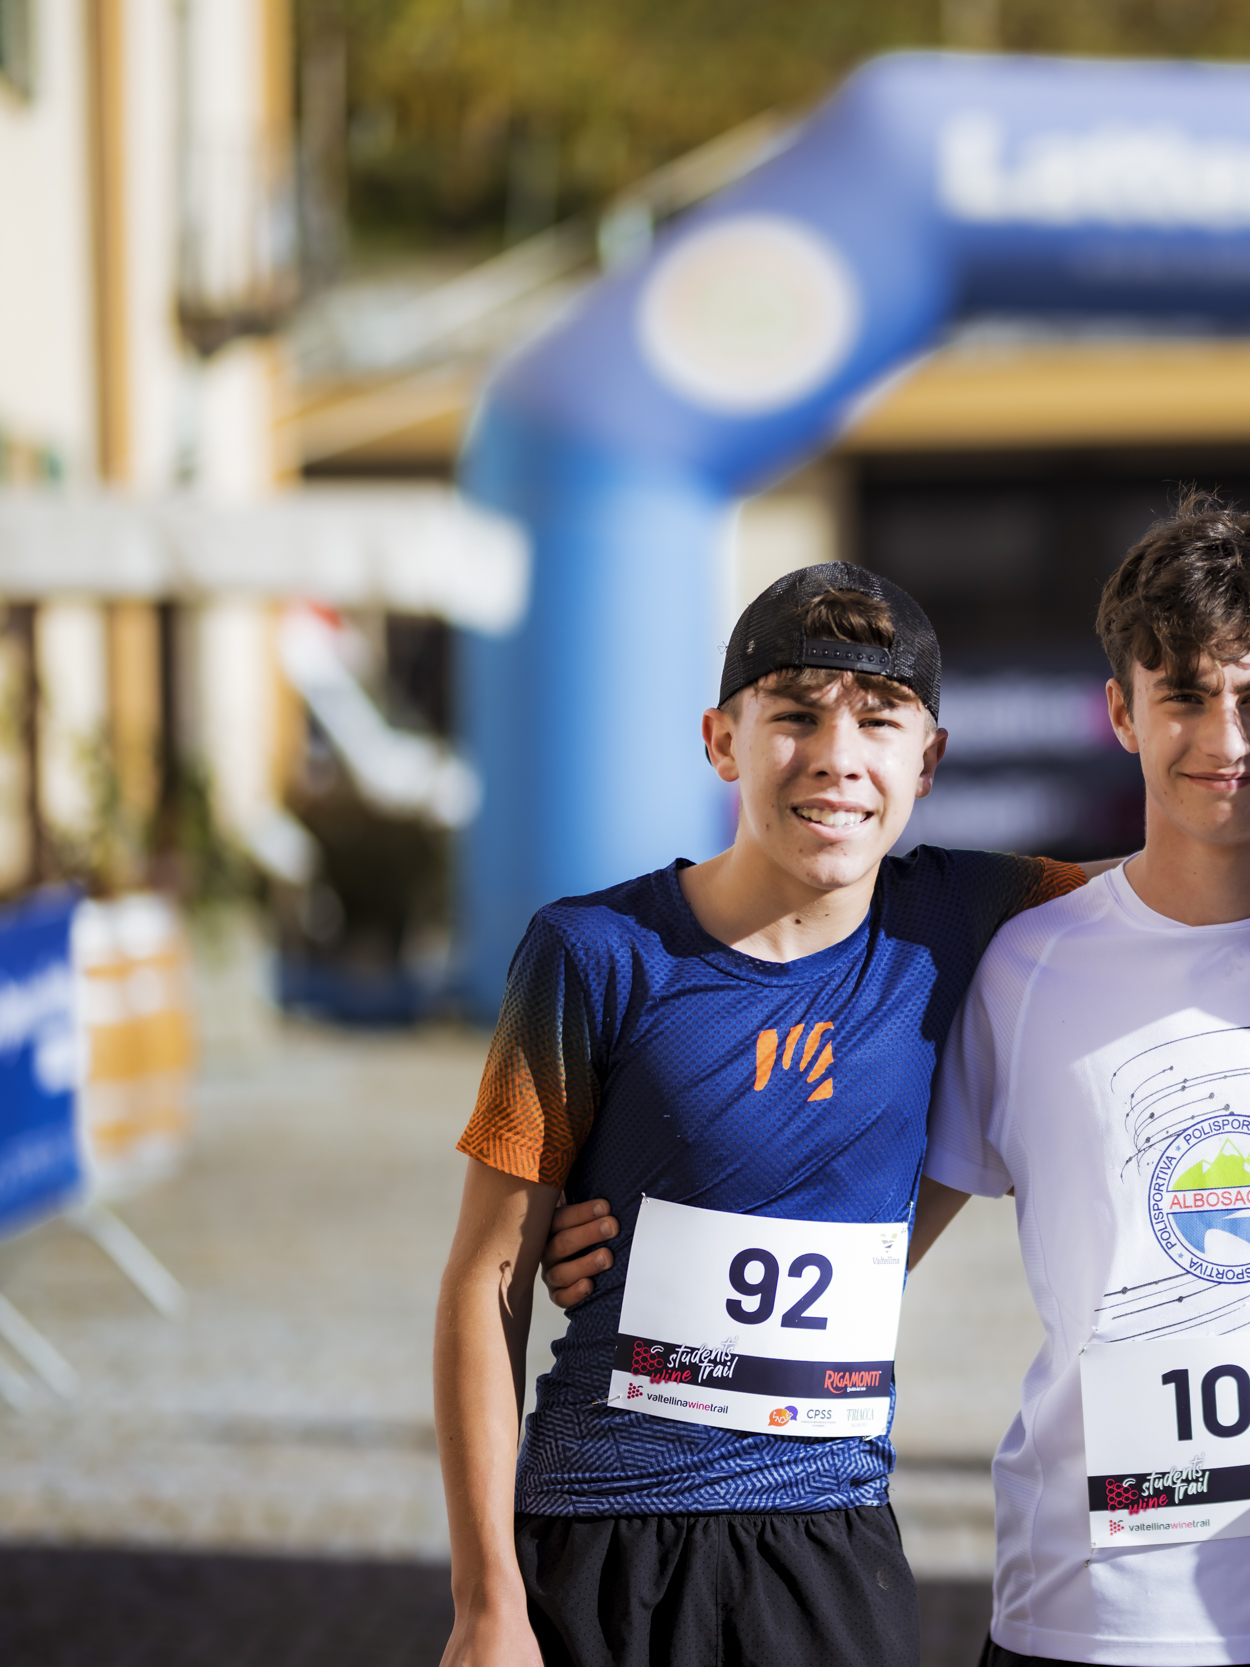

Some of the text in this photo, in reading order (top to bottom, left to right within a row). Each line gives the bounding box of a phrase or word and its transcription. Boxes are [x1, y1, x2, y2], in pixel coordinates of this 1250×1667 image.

[1152, 1153, 1177, 1251] POLISPORTIVA
[725, 1247, 833, 1330] 92
[649, 1356, 739, 1385] wine trail
[824, 1370, 880, 1394] RIGAMONTI
[647, 1393, 729, 1414] valtellinawinetrail
[806, 1409, 832, 1420] CPSS
[1128, 1471, 1210, 1516] wine trail
[1128, 1518, 1211, 1532] valtellinawinetrail
